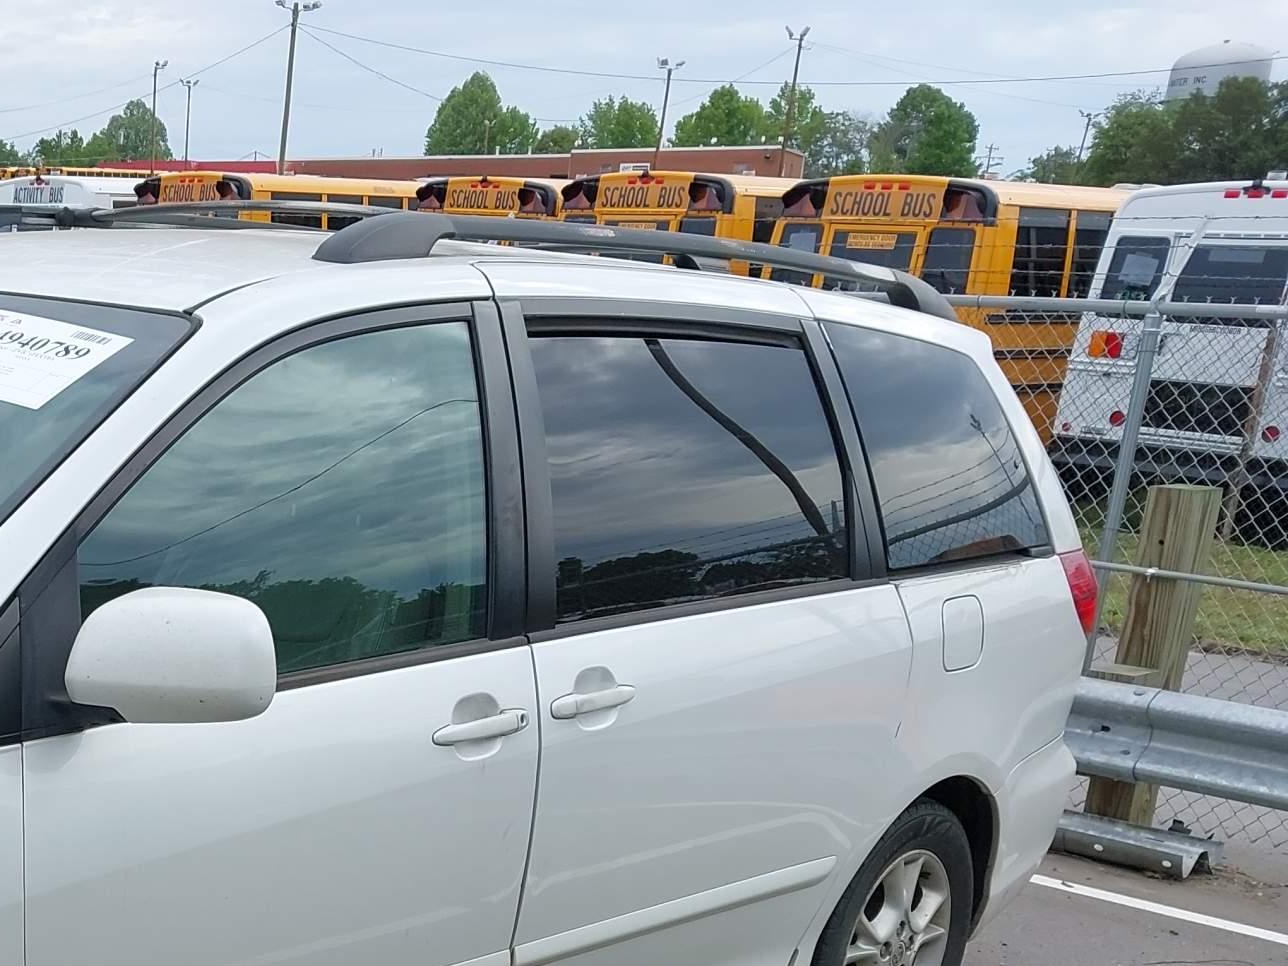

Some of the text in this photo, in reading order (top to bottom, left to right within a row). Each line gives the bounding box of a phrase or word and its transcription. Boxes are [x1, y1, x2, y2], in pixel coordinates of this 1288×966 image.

[13, 186, 64, 204] ACTIVITY BUS
[163, 184, 216, 202] SCHOOL BUS
[450, 189, 516, 210] SCHOOL BUS
[601, 186, 685, 208] SCHOOL BUS
[830, 191, 936, 218] SCHOOL BUS
